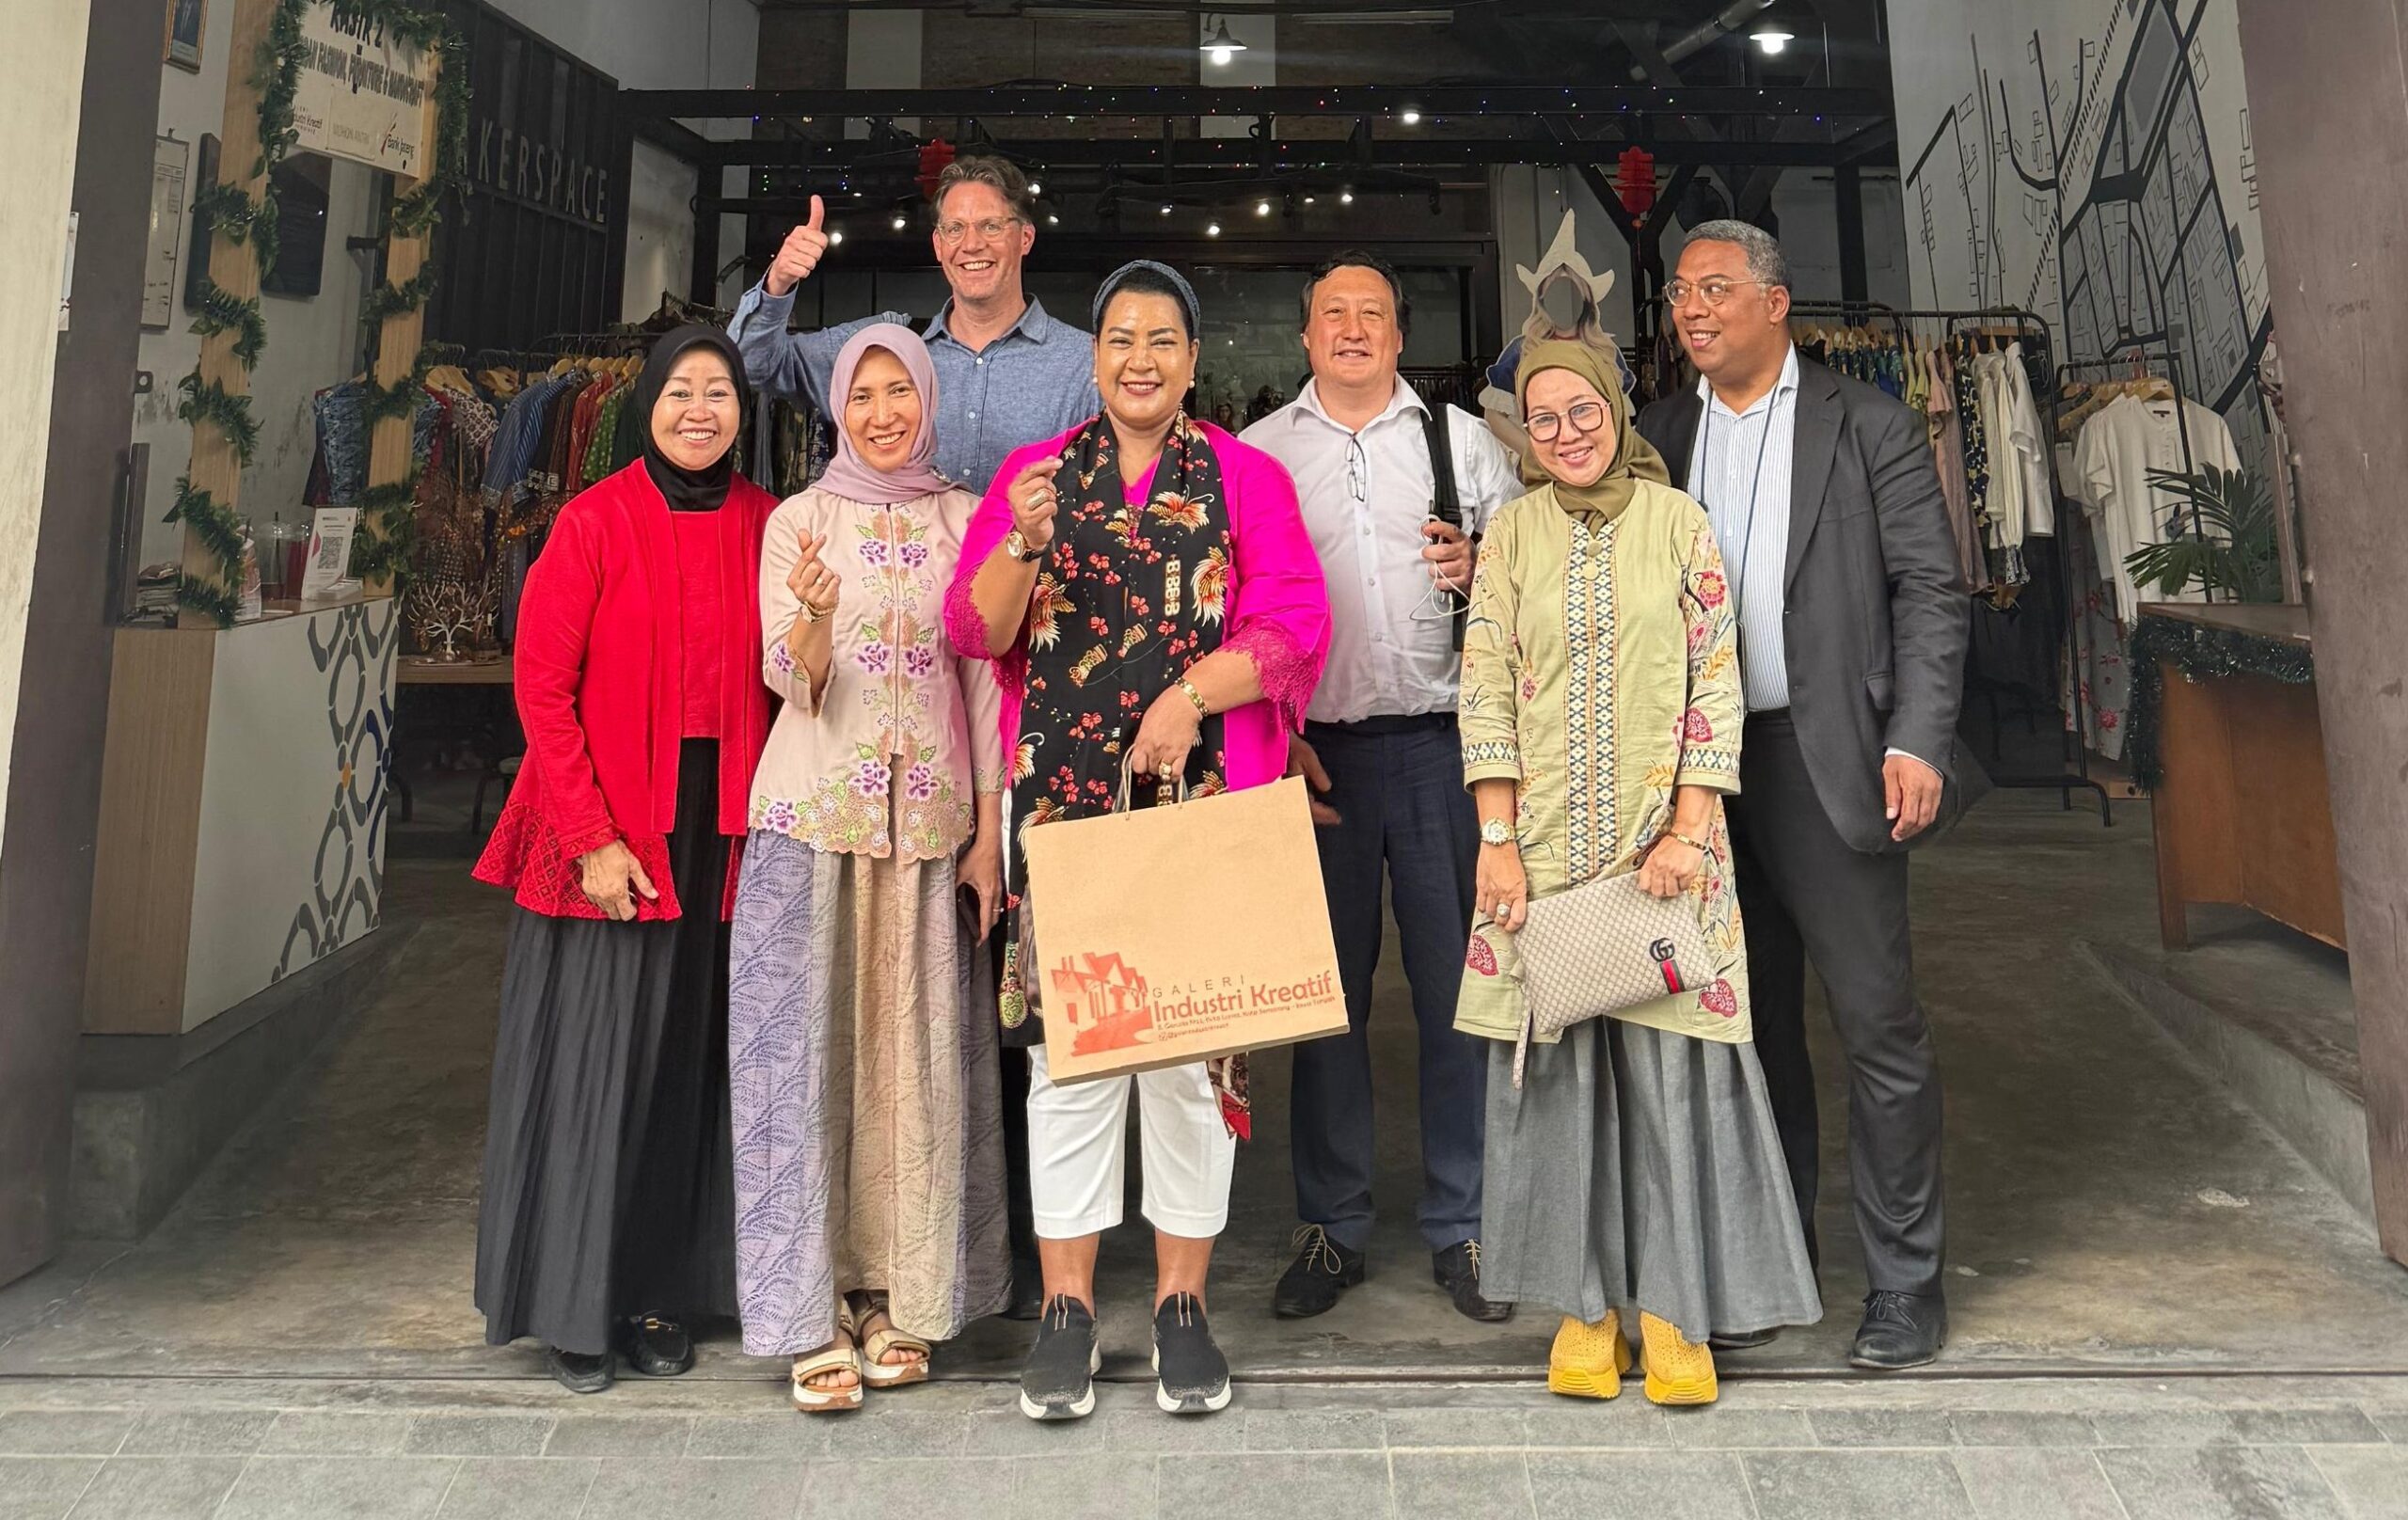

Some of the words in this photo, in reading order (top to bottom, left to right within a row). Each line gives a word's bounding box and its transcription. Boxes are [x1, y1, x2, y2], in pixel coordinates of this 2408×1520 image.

[464, 117, 607, 223] KERSPACE
[1152, 974, 1244, 999] GALERI
[1154, 989, 1243, 1022] Industri
[1250, 970, 1331, 1006] Kreatif
